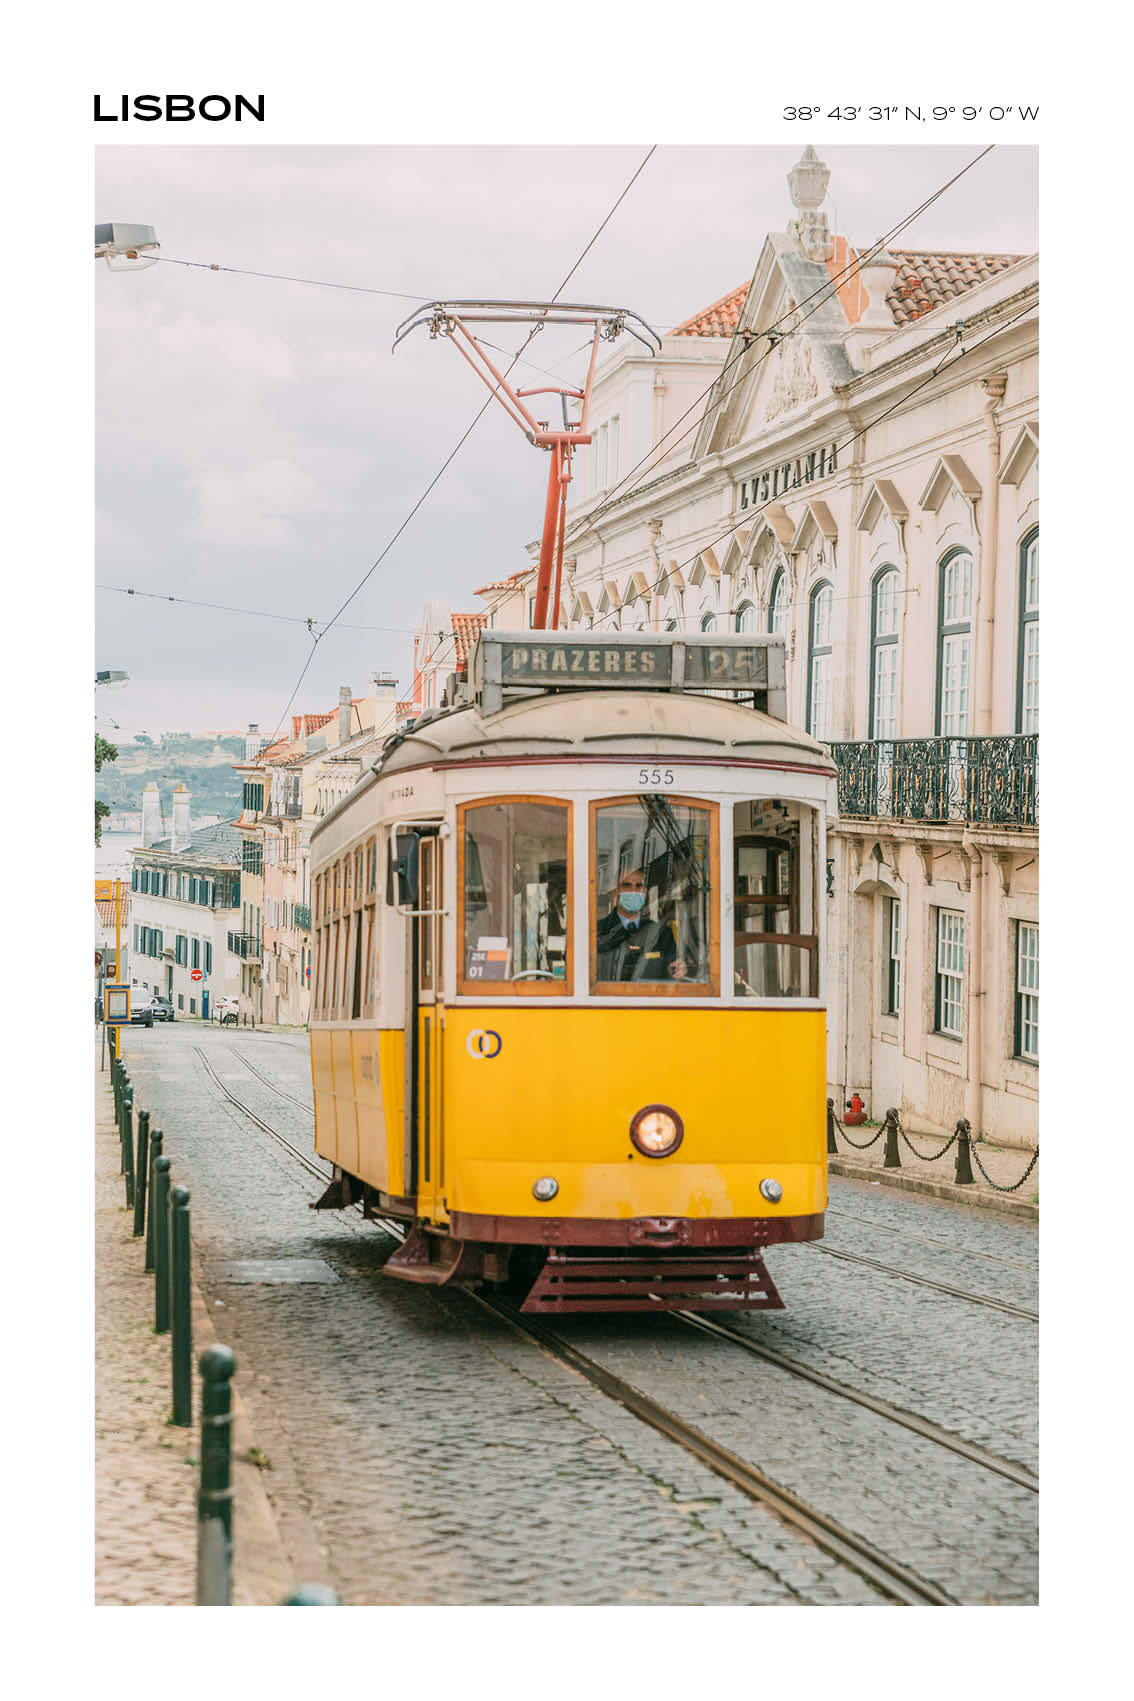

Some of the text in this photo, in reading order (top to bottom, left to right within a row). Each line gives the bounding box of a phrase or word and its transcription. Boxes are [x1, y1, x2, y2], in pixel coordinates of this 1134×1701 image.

[511, 648, 656, 673] PRAZERES
[638, 769, 674, 785] 555
[469, 966, 484, 978] 01
